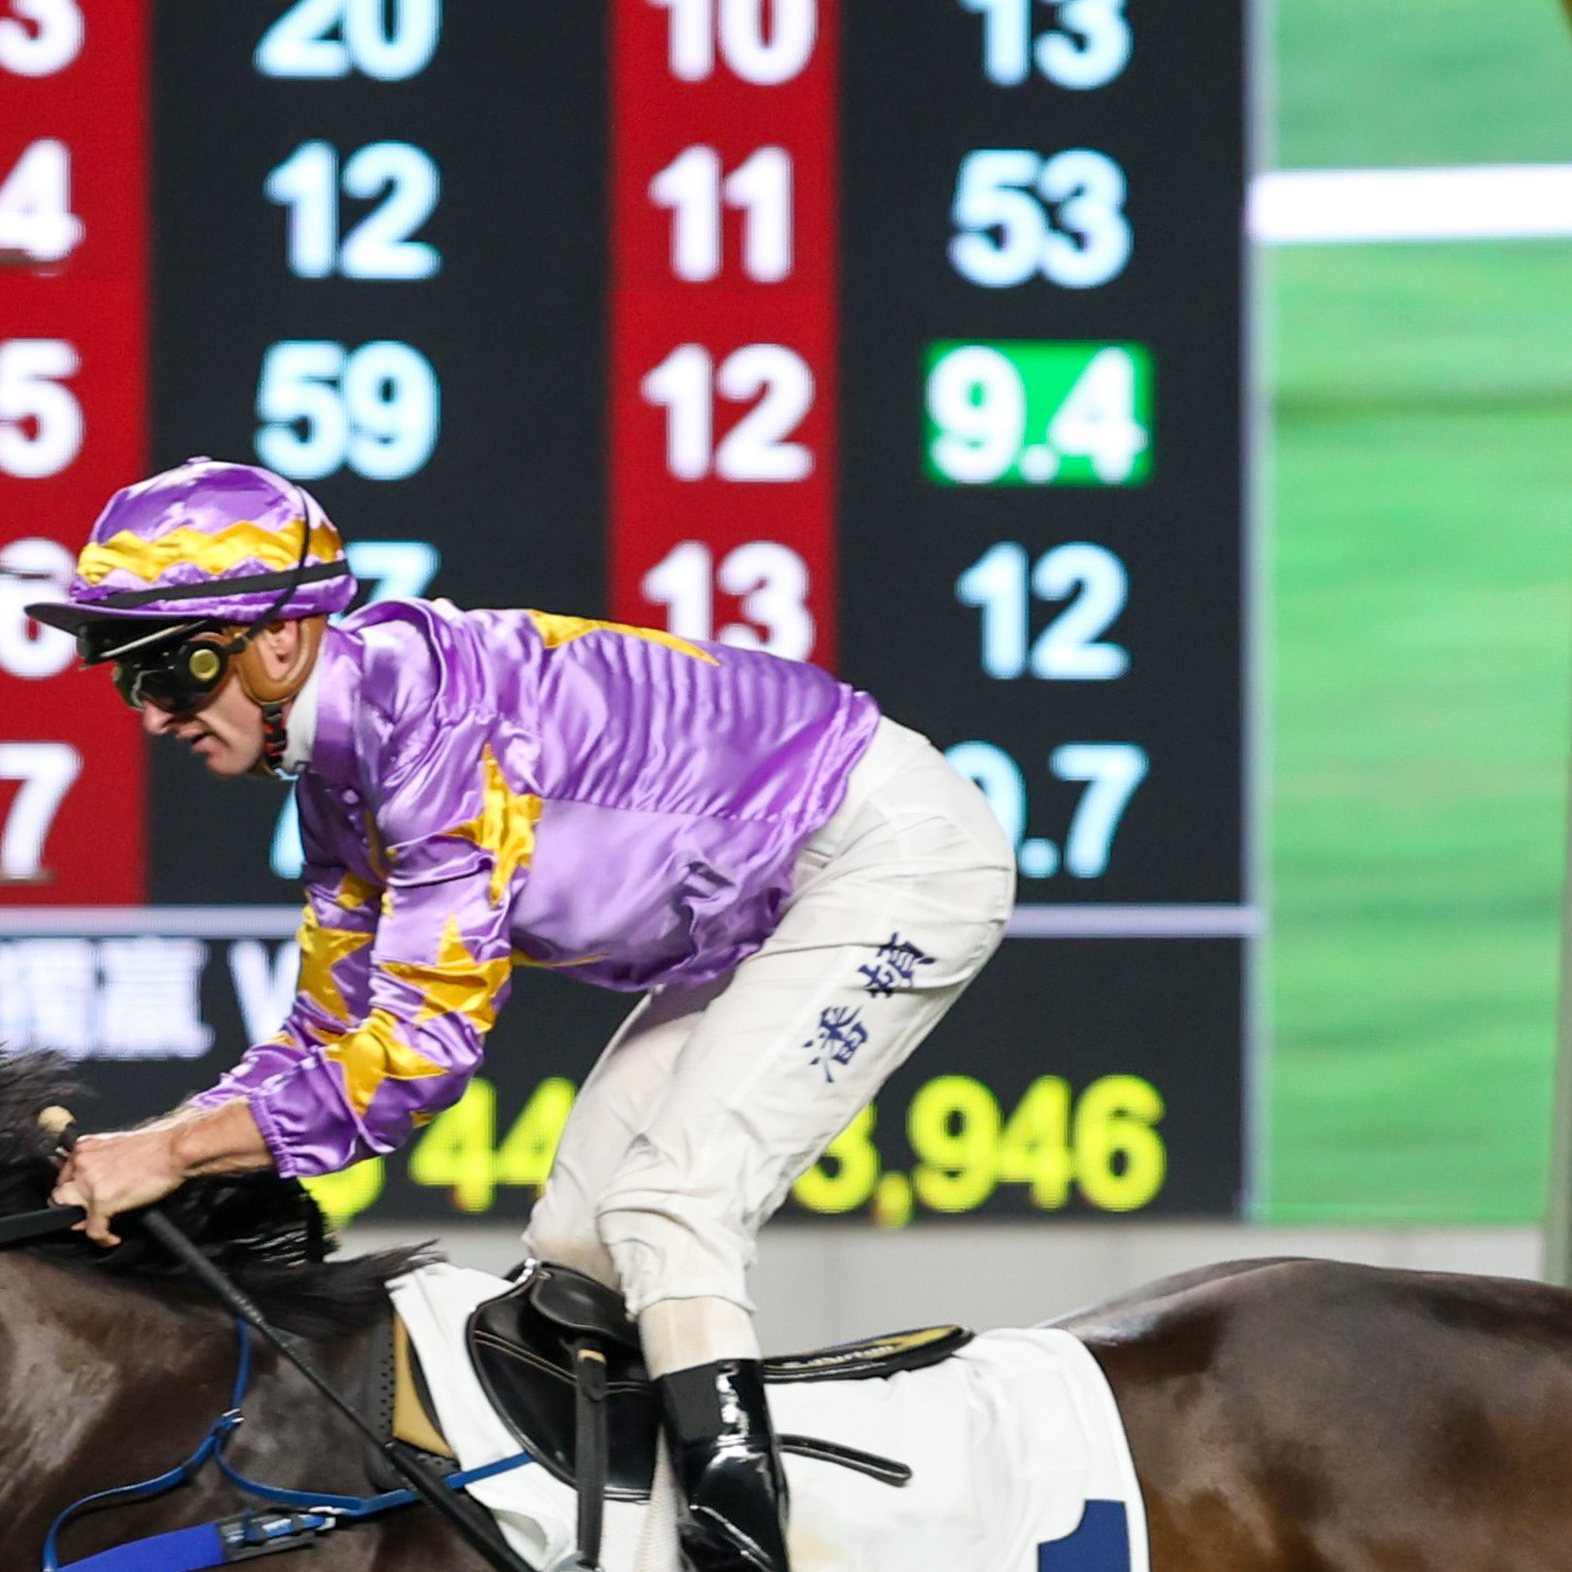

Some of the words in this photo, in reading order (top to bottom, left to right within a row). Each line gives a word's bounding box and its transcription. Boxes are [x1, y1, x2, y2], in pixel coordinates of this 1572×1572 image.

[254, 0, 442, 81] 20
[651, 0, 818, 85] 10
[963, 0, 1133, 89] 13
[265, 141, 442, 279] 12
[648, 145, 792, 282] 11
[949, 149, 1133, 288] 53
[254, 340, 441, 480] 59
[641, 344, 815, 482] 12
[926, 346, 1149, 484] 9.4
[641, 540, 816, 662] 13
[956, 541, 1129, 680] 12
